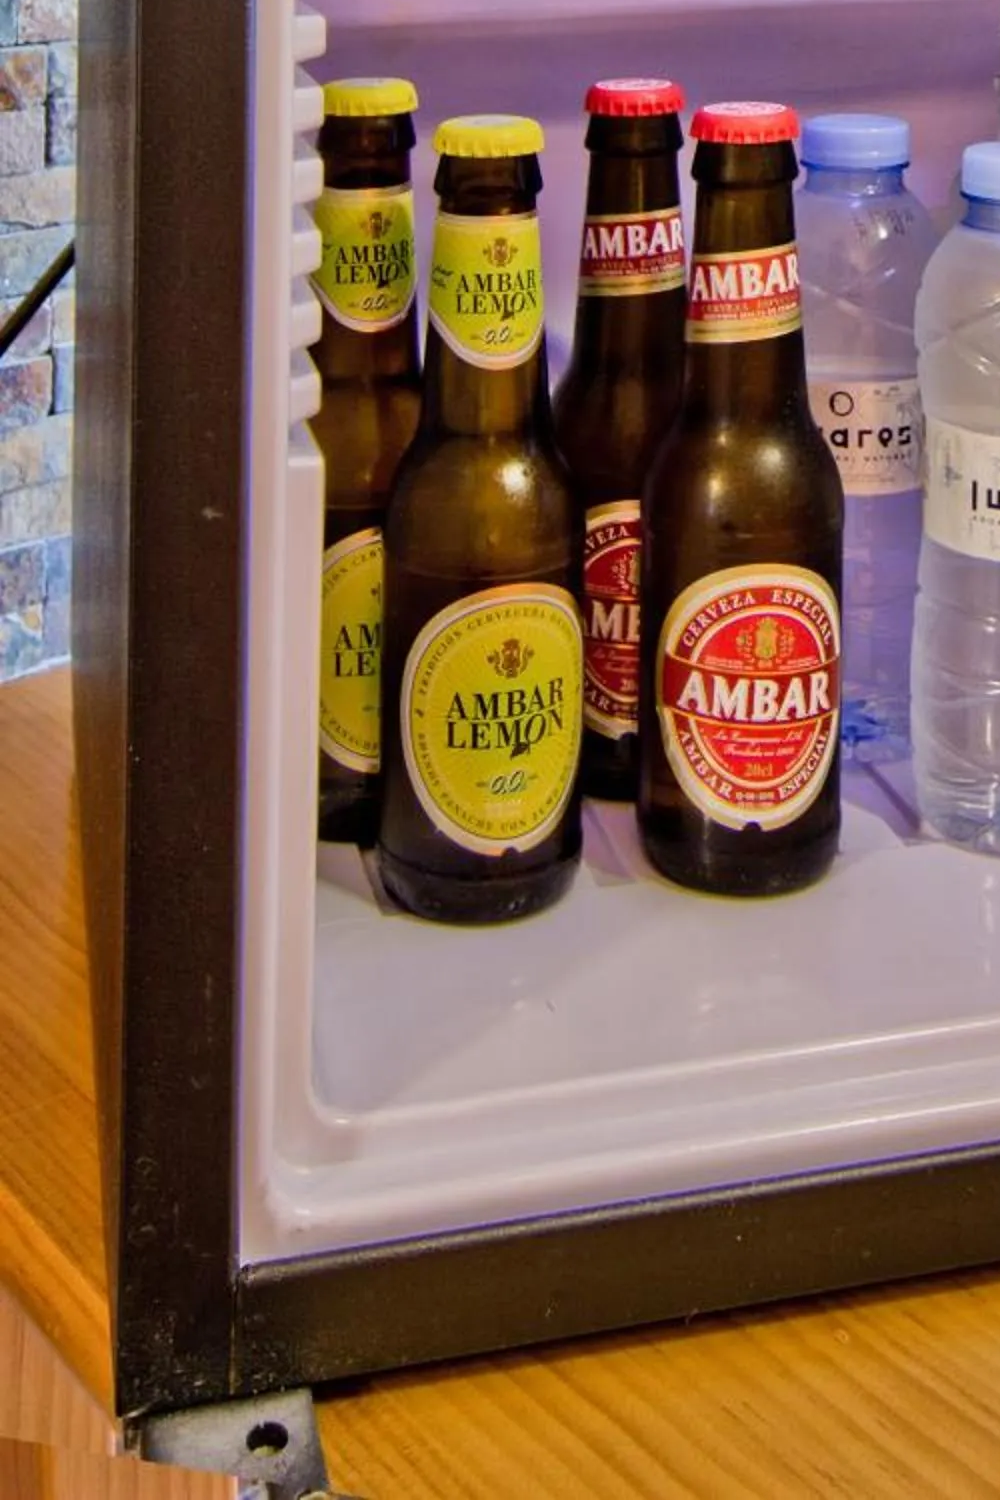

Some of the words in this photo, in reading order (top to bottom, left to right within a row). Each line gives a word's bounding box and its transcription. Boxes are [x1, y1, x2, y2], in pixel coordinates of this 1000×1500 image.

[335, 239, 410, 265] AMBAR
[583, 218, 684, 259] AMBAR
[335, 258, 410, 286] LEMON
[456, 269, 537, 294] AMBAR
[691, 252, 801, 301] AMBAR
[456, 290, 537, 316] LEMON
[820, 425, 912, 449] ares
[585, 524, 630, 549] VEZA
[682, 590, 756, 648] CERVEZA
[771, 589, 833, 645] ESPECIAL
[447, 677, 563, 721] AMBAR
[677, 669, 831, 723] AMBAR
[446, 706, 563, 751] LEMON
[679, 730, 734, 799] AMBAR
[778, 730, 830, 800] ESPECIAL
